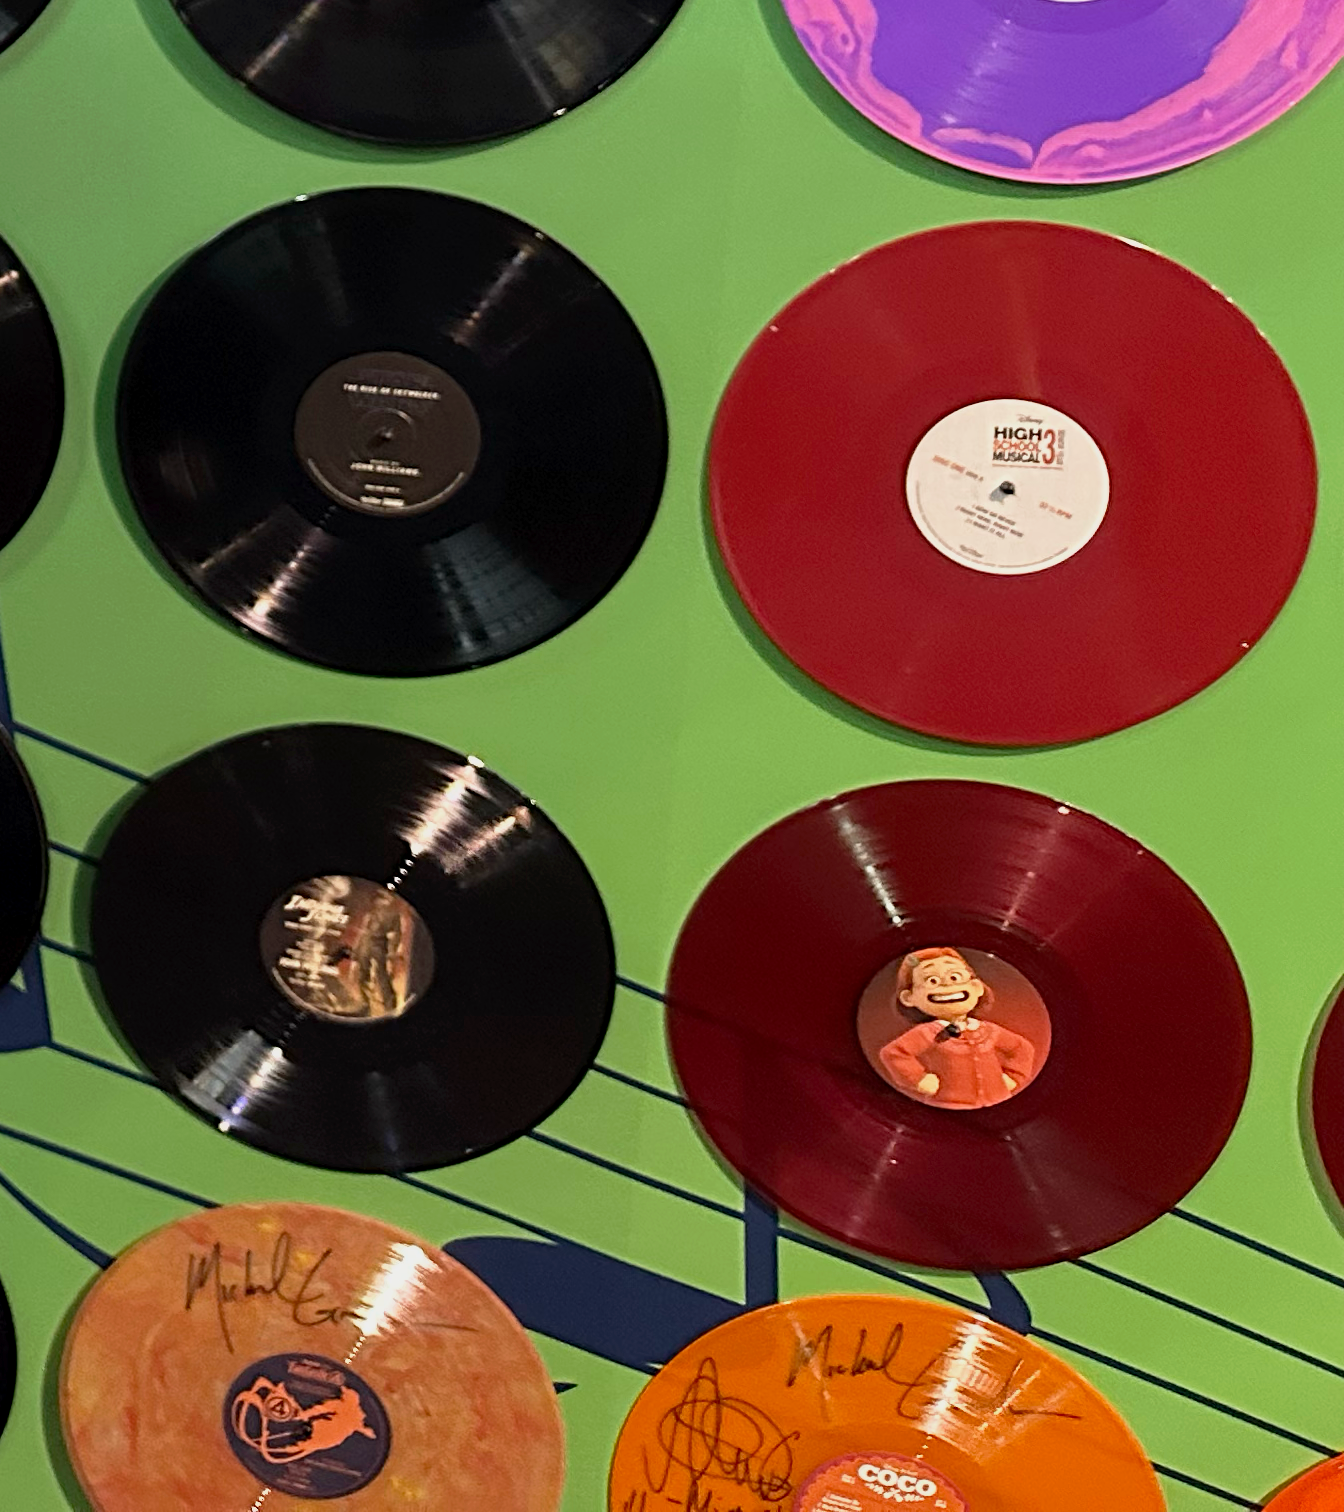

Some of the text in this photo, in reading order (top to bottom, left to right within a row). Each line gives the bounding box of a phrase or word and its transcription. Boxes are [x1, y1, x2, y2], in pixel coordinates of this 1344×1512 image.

[1016, 413, 1043, 425] Disney
[993, 439, 1041, 453] SCHOOL
[994, 426, 1042, 441] HIGH
[1042, 429, 1056, 464] 3
[992, 451, 1040, 464] MUSICAL
[858, 1464, 937, 1497] COCO
